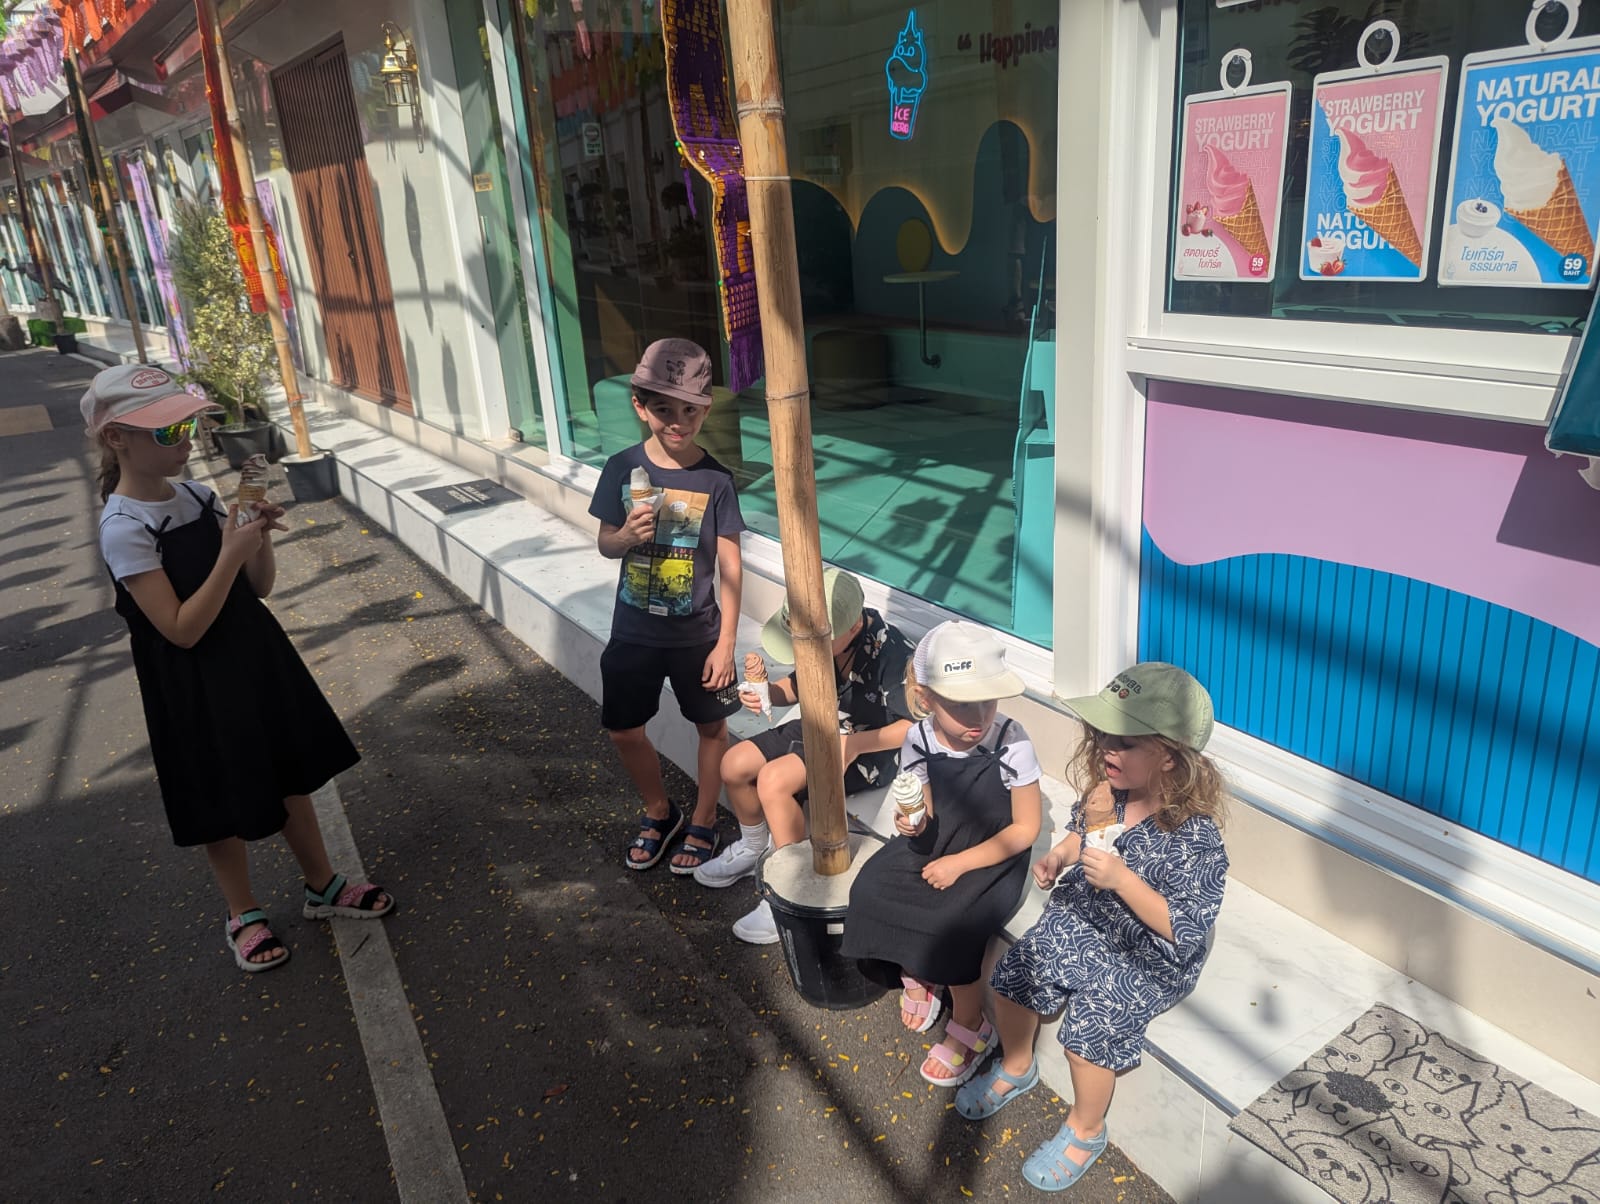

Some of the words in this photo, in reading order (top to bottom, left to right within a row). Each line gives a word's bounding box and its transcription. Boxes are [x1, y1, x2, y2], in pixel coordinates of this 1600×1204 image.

[979, 21, 1058, 70] Happine
[1476, 66, 1600, 103] NATURAL
[1325, 89, 1425, 118] STRAWBERRY
[1476, 92, 1600, 127] YOGURT
[1194, 111, 1276, 135] STRAWBERRY
[1325, 108, 1423, 137] YOGURT
[1194, 129, 1274, 153] YOGURT
[1252, 257, 1264, 267] 59
[1461, 245, 1504, 261] โยเกิร์ต
[1564, 258, 1583, 270] 59
